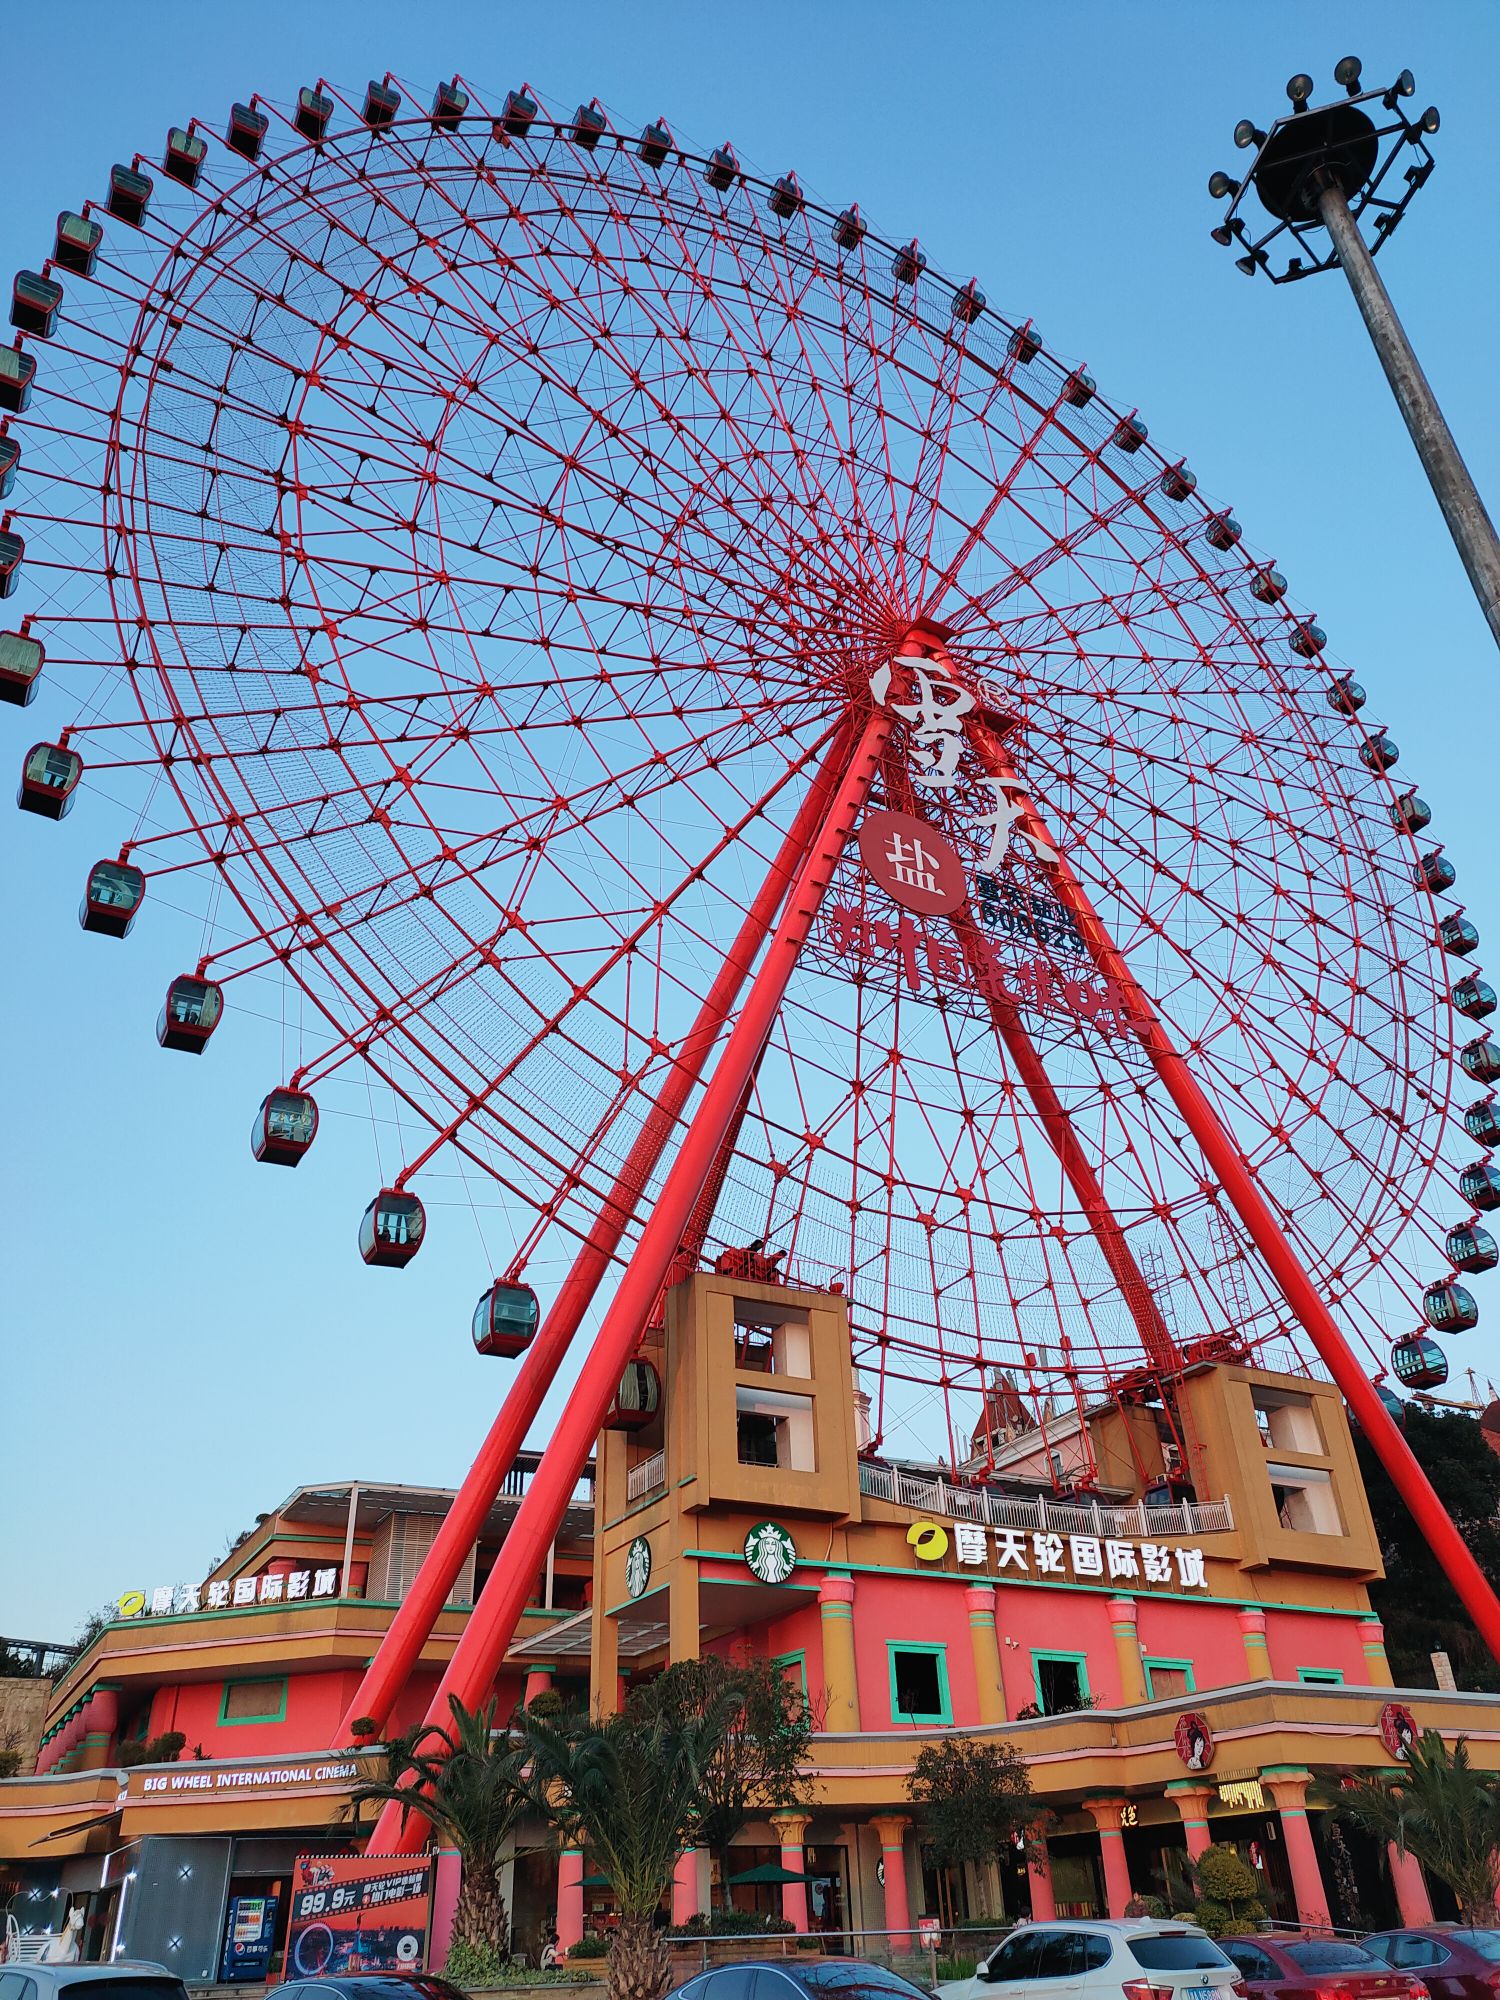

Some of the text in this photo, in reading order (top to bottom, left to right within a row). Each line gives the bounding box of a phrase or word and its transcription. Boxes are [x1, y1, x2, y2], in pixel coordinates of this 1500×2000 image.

[884, 832, 947, 897] 盐
[953, 1522, 1208, 1588] 摩天轮国际影城
[151, 1567, 337, 1612] 摩天轮国际影城
[144, 1763, 357, 1791] BIG WHEEL INTERNATIONAL CINEMA
